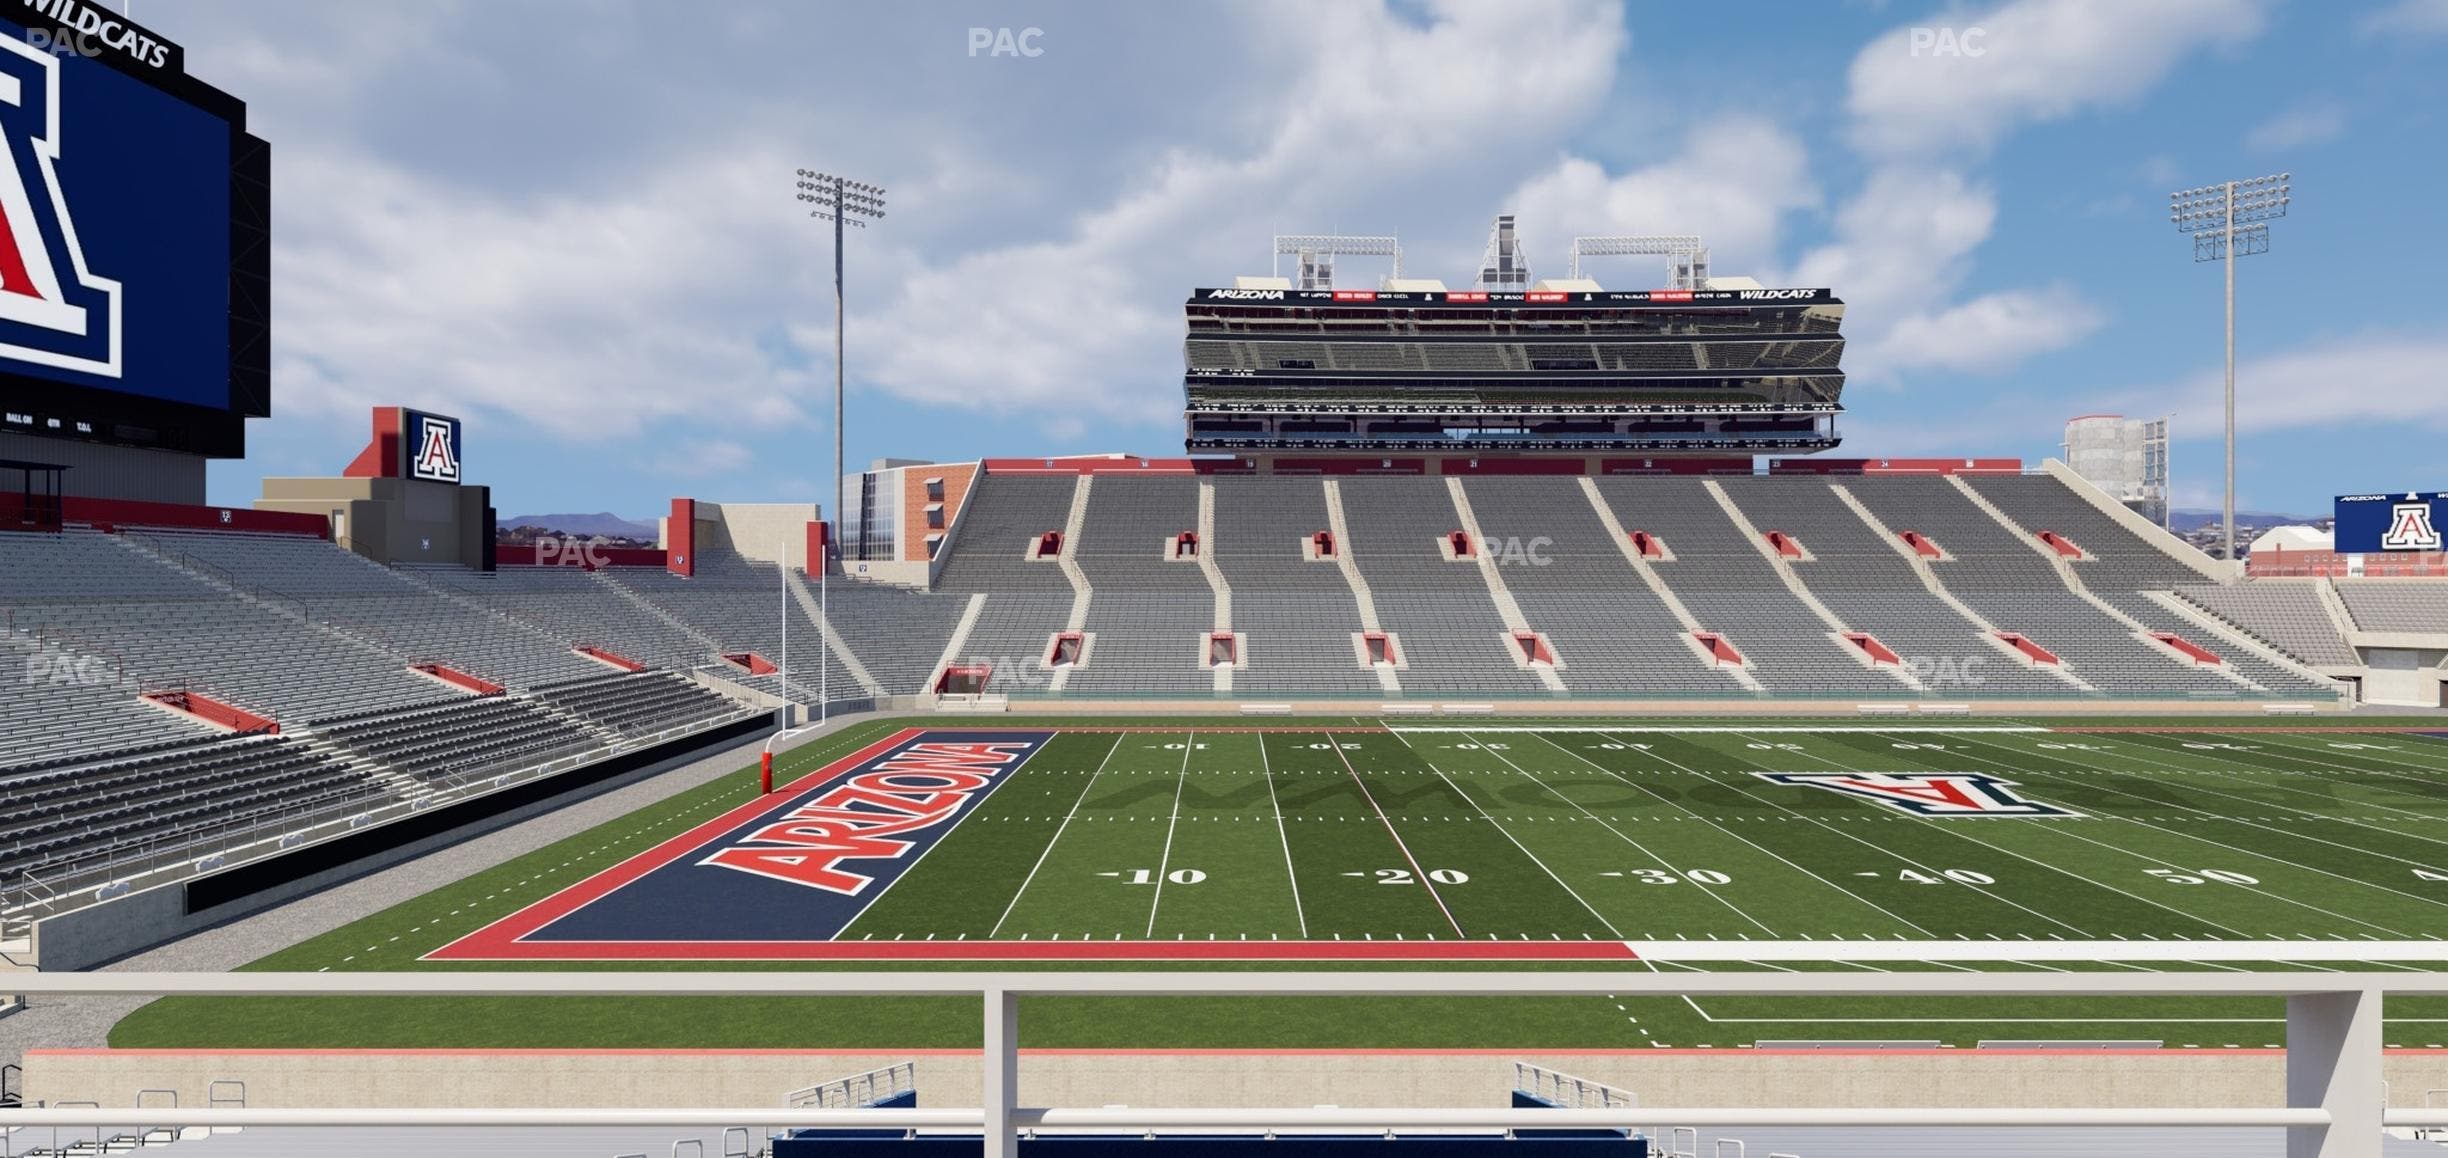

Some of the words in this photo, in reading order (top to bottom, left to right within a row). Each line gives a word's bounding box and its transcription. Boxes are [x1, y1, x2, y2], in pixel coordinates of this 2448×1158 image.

[22, 0, 169, 69] WILDCATS
[1208, 289, 1285, 301] ARIZONA
[1739, 289, 1818, 301] WILDCATS
[414, 416, 460, 482] A
[2340, 495, 2387, 503] ARIZONA
[2382, 503, 2441, 550] A
[694, 742, 1033, 896] ARIZONA
[1122, 868, 1207, 885] 10
[1375, 868, 1469, 885] 20
[1631, 868, 1732, 885] 30
[1899, 868, 1996, 885] 40
[2142, 868, 2260, 885] 50
[2411, 868, 2448, 881] 4
